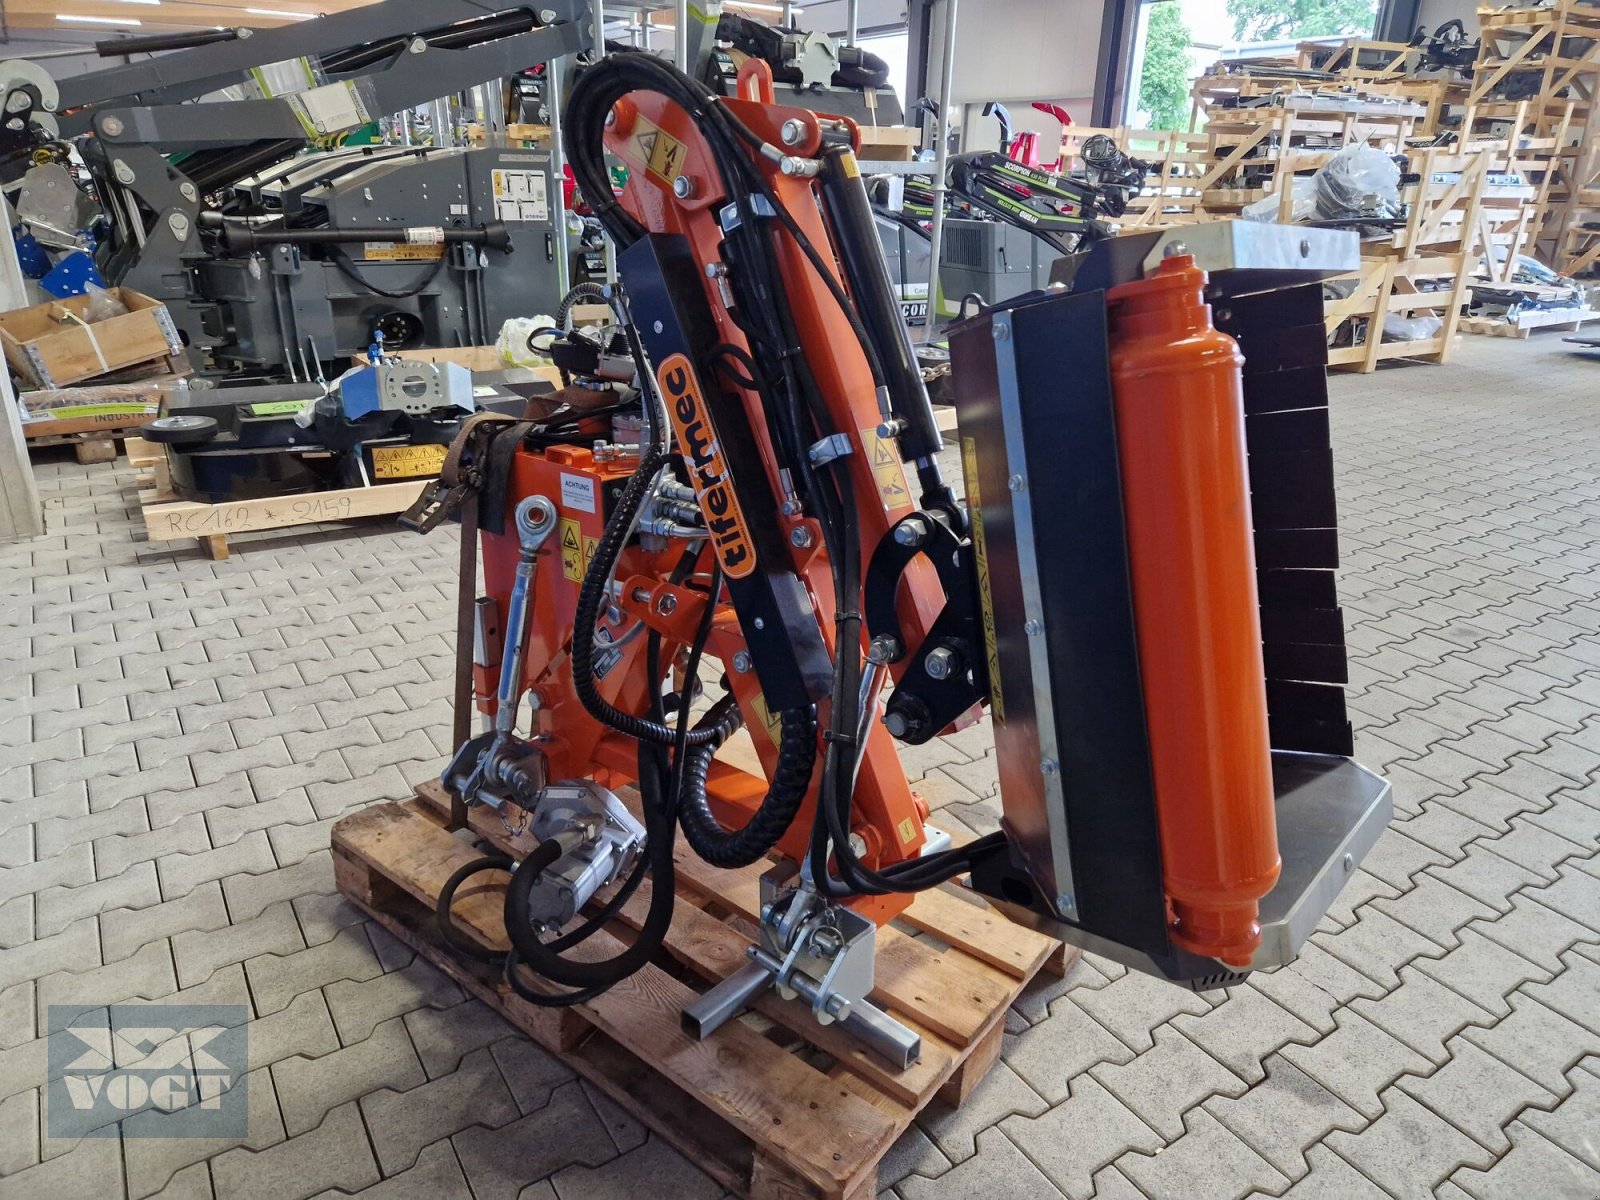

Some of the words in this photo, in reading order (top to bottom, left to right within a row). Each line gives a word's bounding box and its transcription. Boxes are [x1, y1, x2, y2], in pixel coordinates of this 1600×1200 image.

[1004, 161, 1031, 177] SCORPION
[665, 366, 747, 568] tifermec
[565, 480, 590, 491] ACHTUNG
